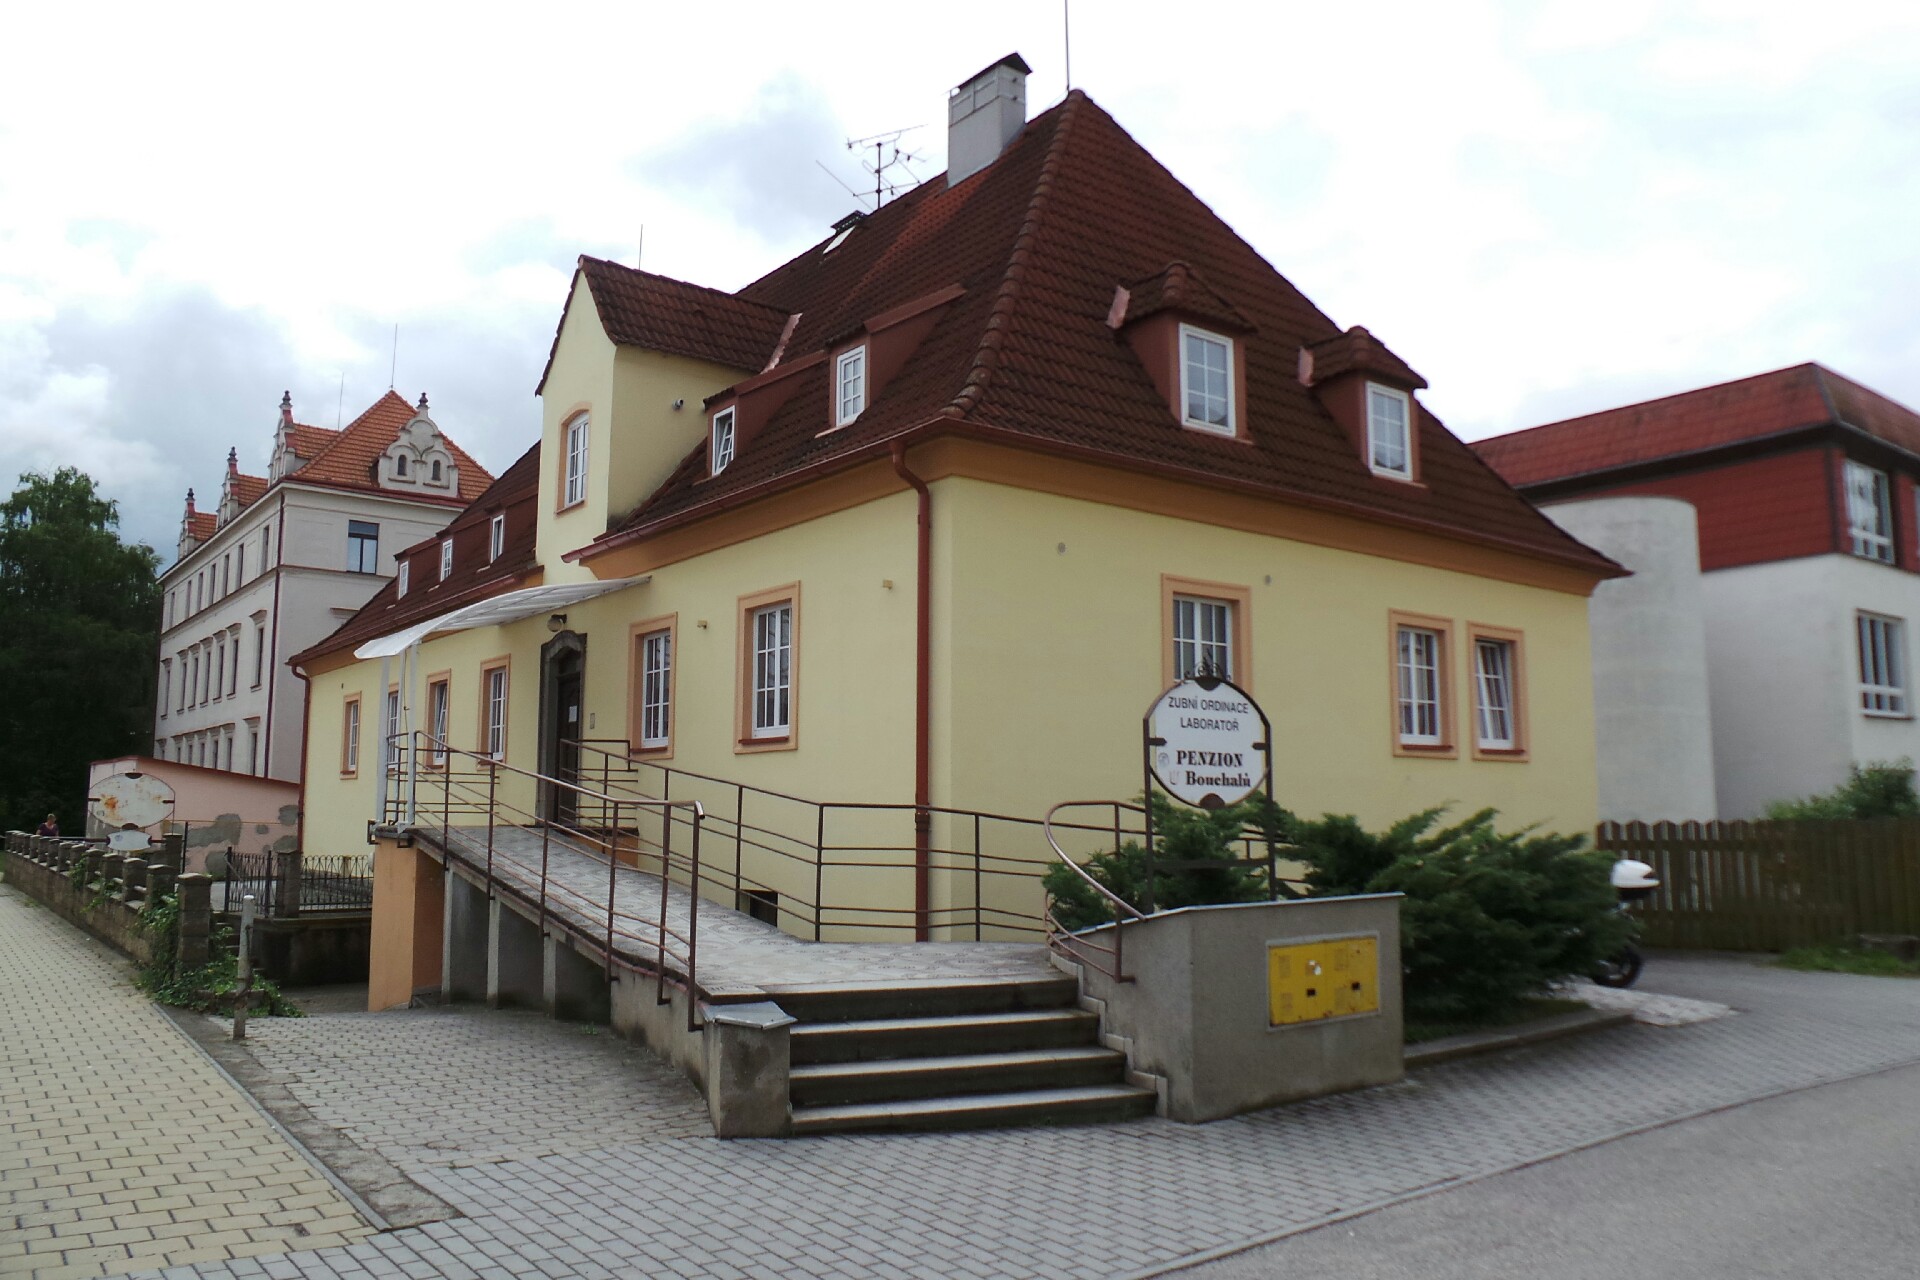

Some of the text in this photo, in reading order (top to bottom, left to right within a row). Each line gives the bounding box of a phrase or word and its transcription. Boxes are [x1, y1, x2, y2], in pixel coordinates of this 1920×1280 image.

[1201, 699, 1249, 714] ORDINACE
[1176, 750, 1243, 767] PENZION
[1185, 771, 1251, 787] Bouchalů
